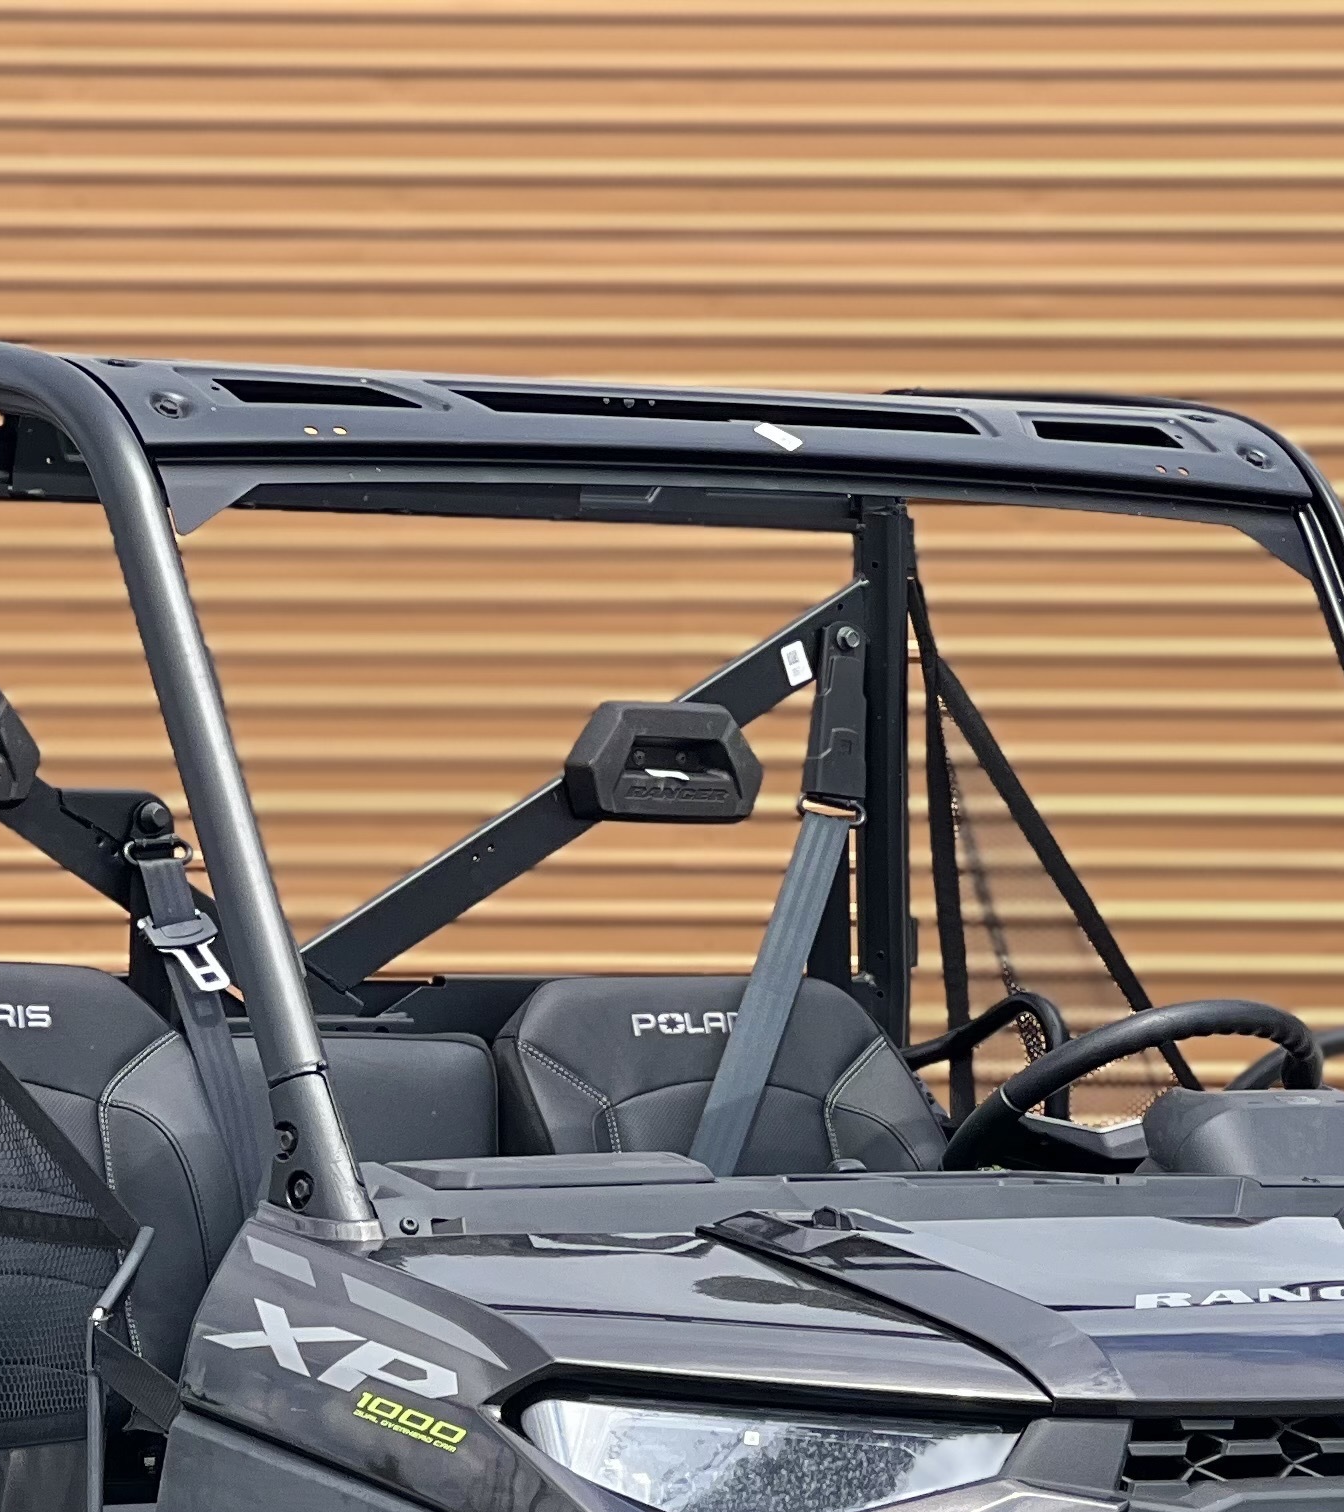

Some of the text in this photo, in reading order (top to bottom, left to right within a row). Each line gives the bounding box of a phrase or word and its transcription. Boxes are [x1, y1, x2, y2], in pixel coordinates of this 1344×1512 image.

[202, 1297, 459, 1400] XP
[352, 1408, 457, 1454] DUAL OVERHEAD CAM
[356, 1391, 468, 1445] 1000
